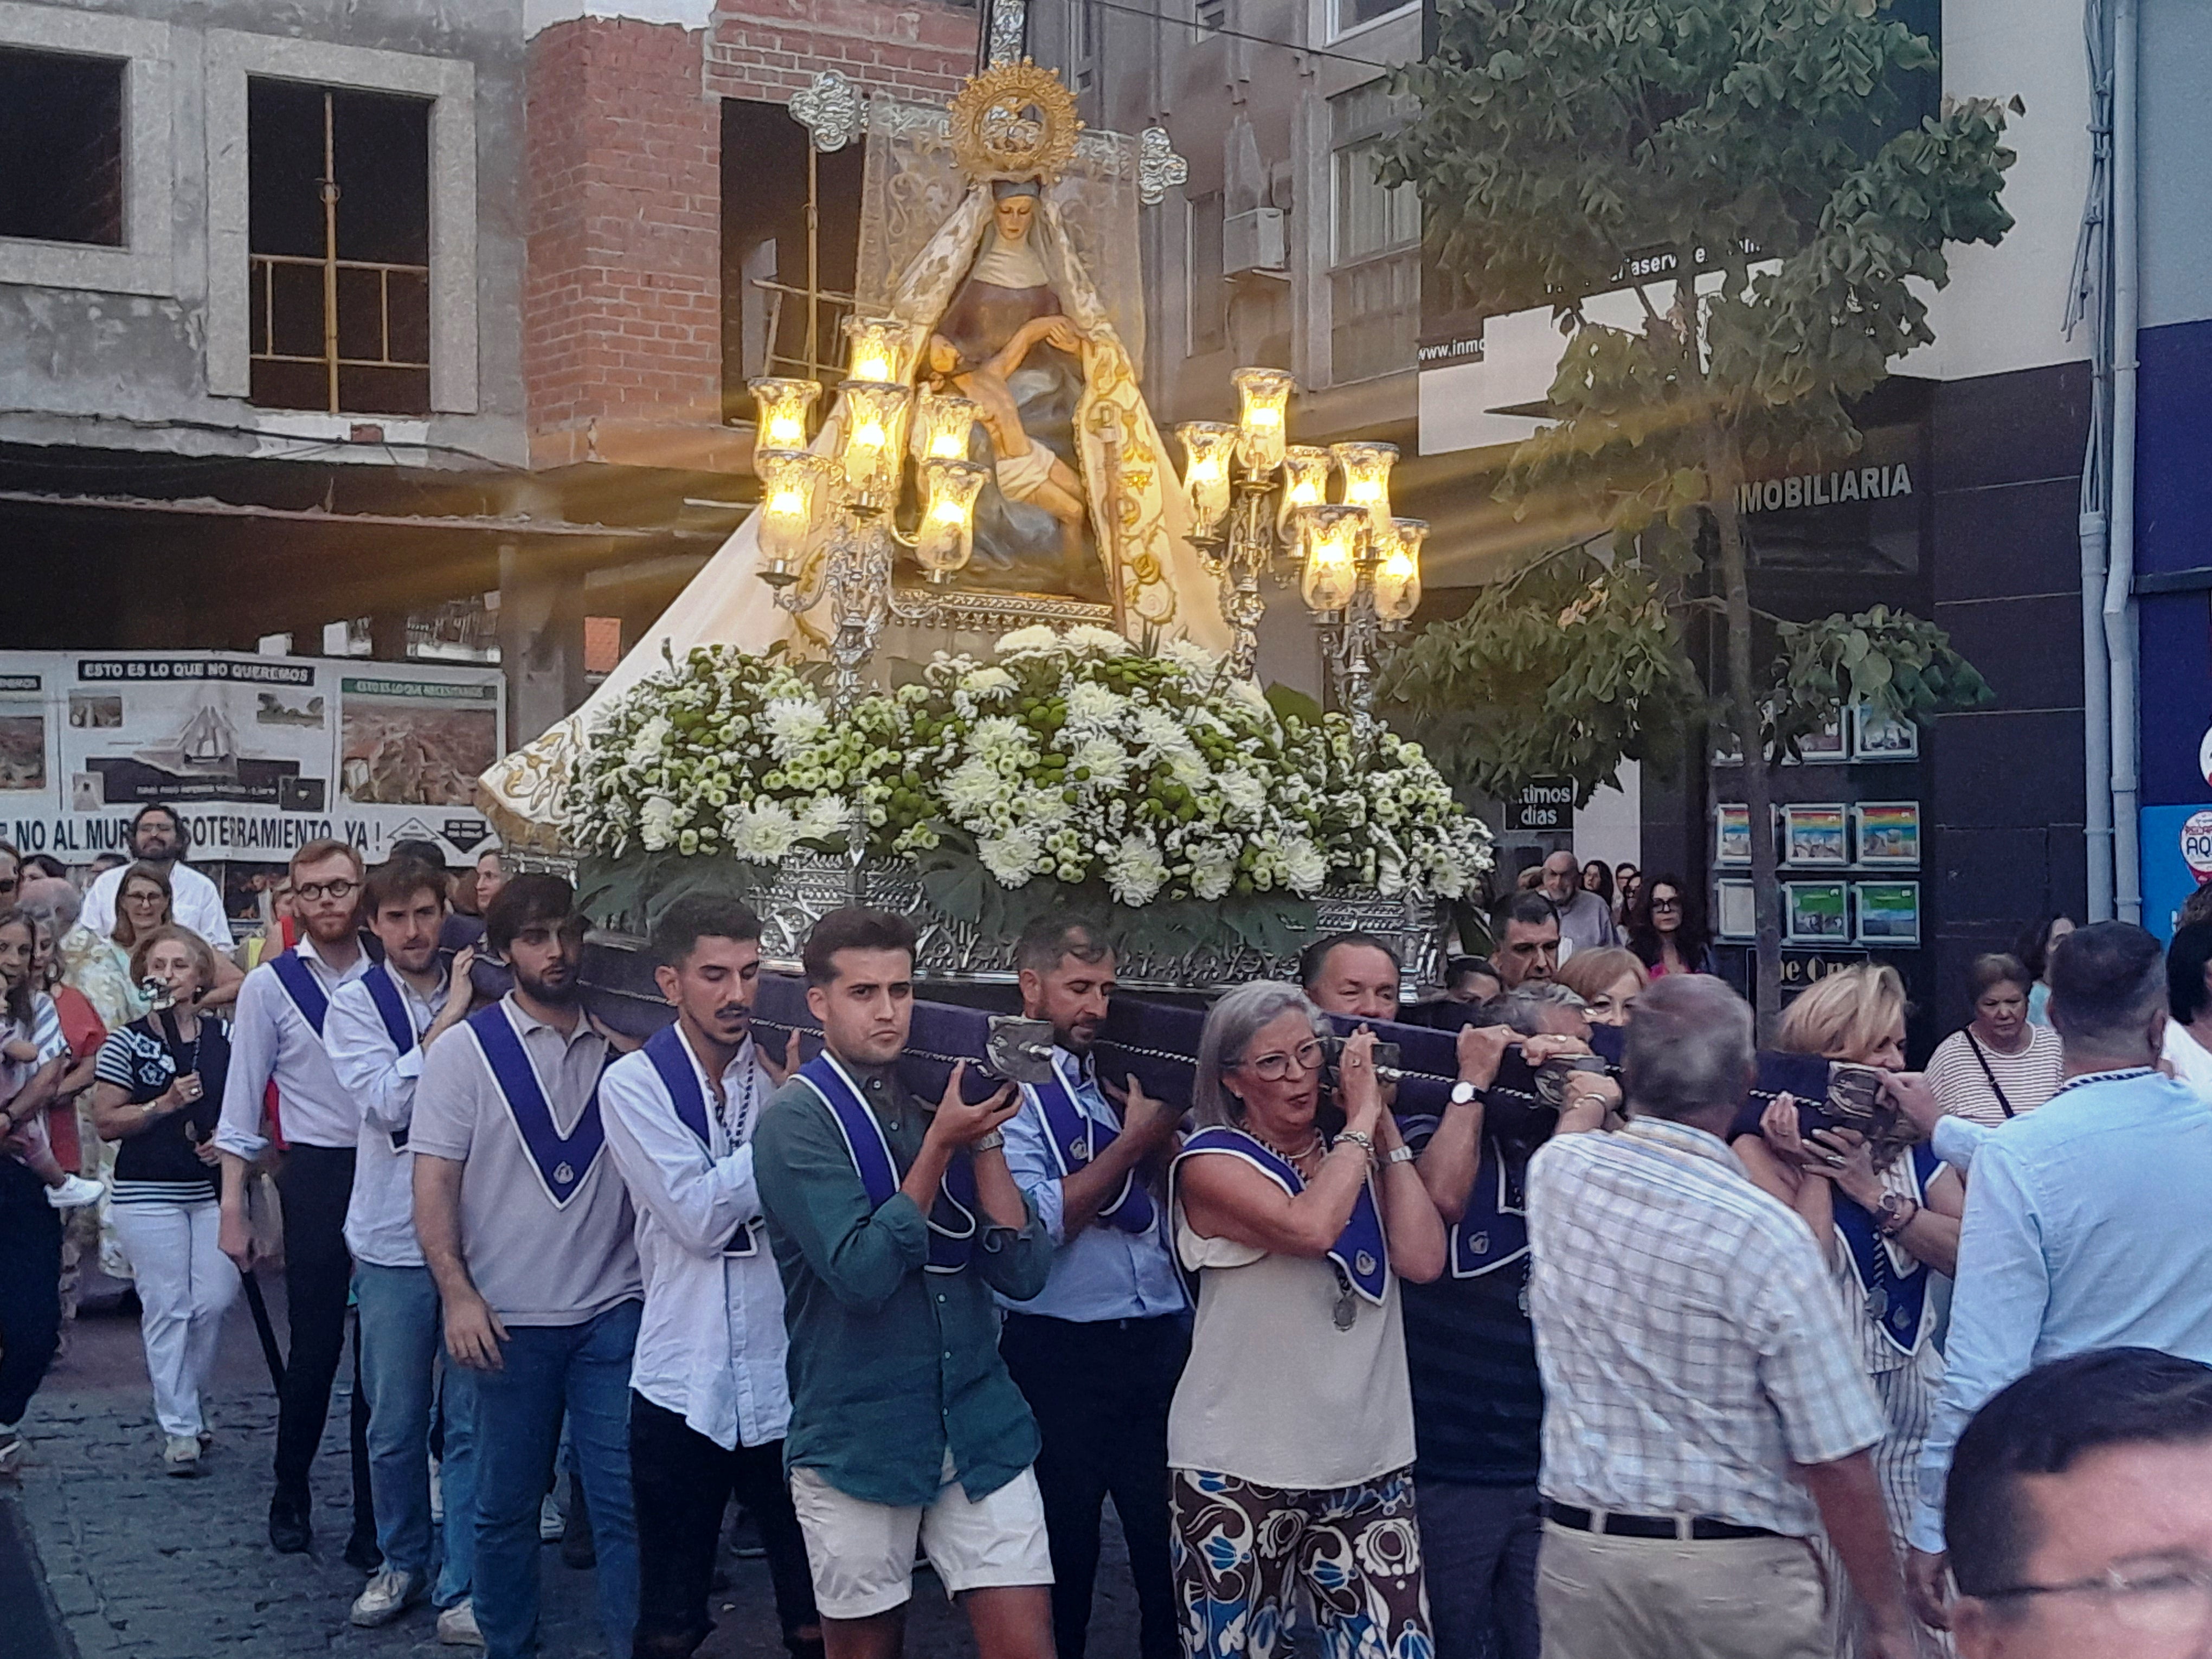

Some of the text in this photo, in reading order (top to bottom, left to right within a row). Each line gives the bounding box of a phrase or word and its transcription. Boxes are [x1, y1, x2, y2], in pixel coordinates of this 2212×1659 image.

[85, 663, 123, 678] ESTO
[127, 663, 146, 677] ES
[150, 663, 169, 677] LO
[172, 663, 203, 677] QUE
[208, 663, 228, 677] NO
[16, 820, 46, 852] NO
[54, 819, 79, 850] AL
[86, 818, 132, 850] MUR
[345, 820, 368, 851] YA
[2187, 835, 2212, 857] AQ
